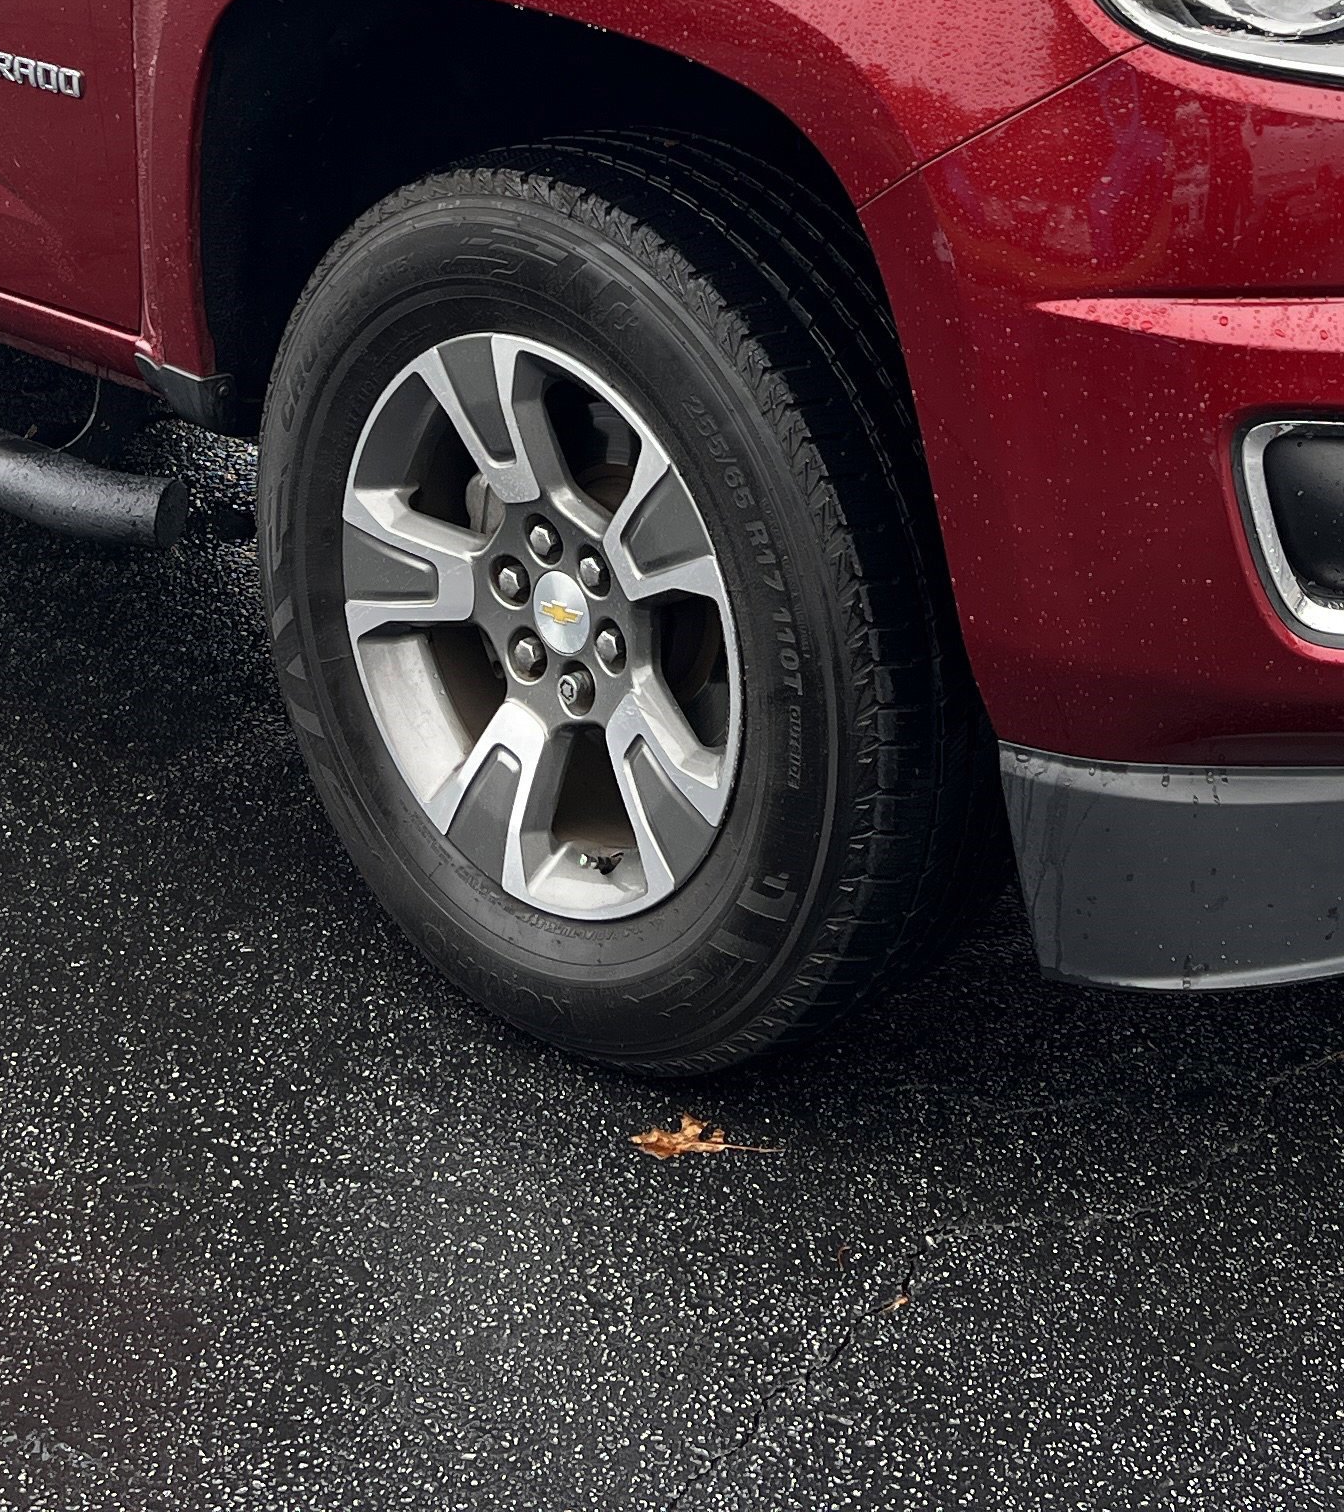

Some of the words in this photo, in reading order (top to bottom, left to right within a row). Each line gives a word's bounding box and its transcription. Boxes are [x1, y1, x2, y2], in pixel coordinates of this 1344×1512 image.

[681, 393, 757, 511] 255/65
[745, 518, 786, 593] R17
[771, 605, 803, 695] 110T
